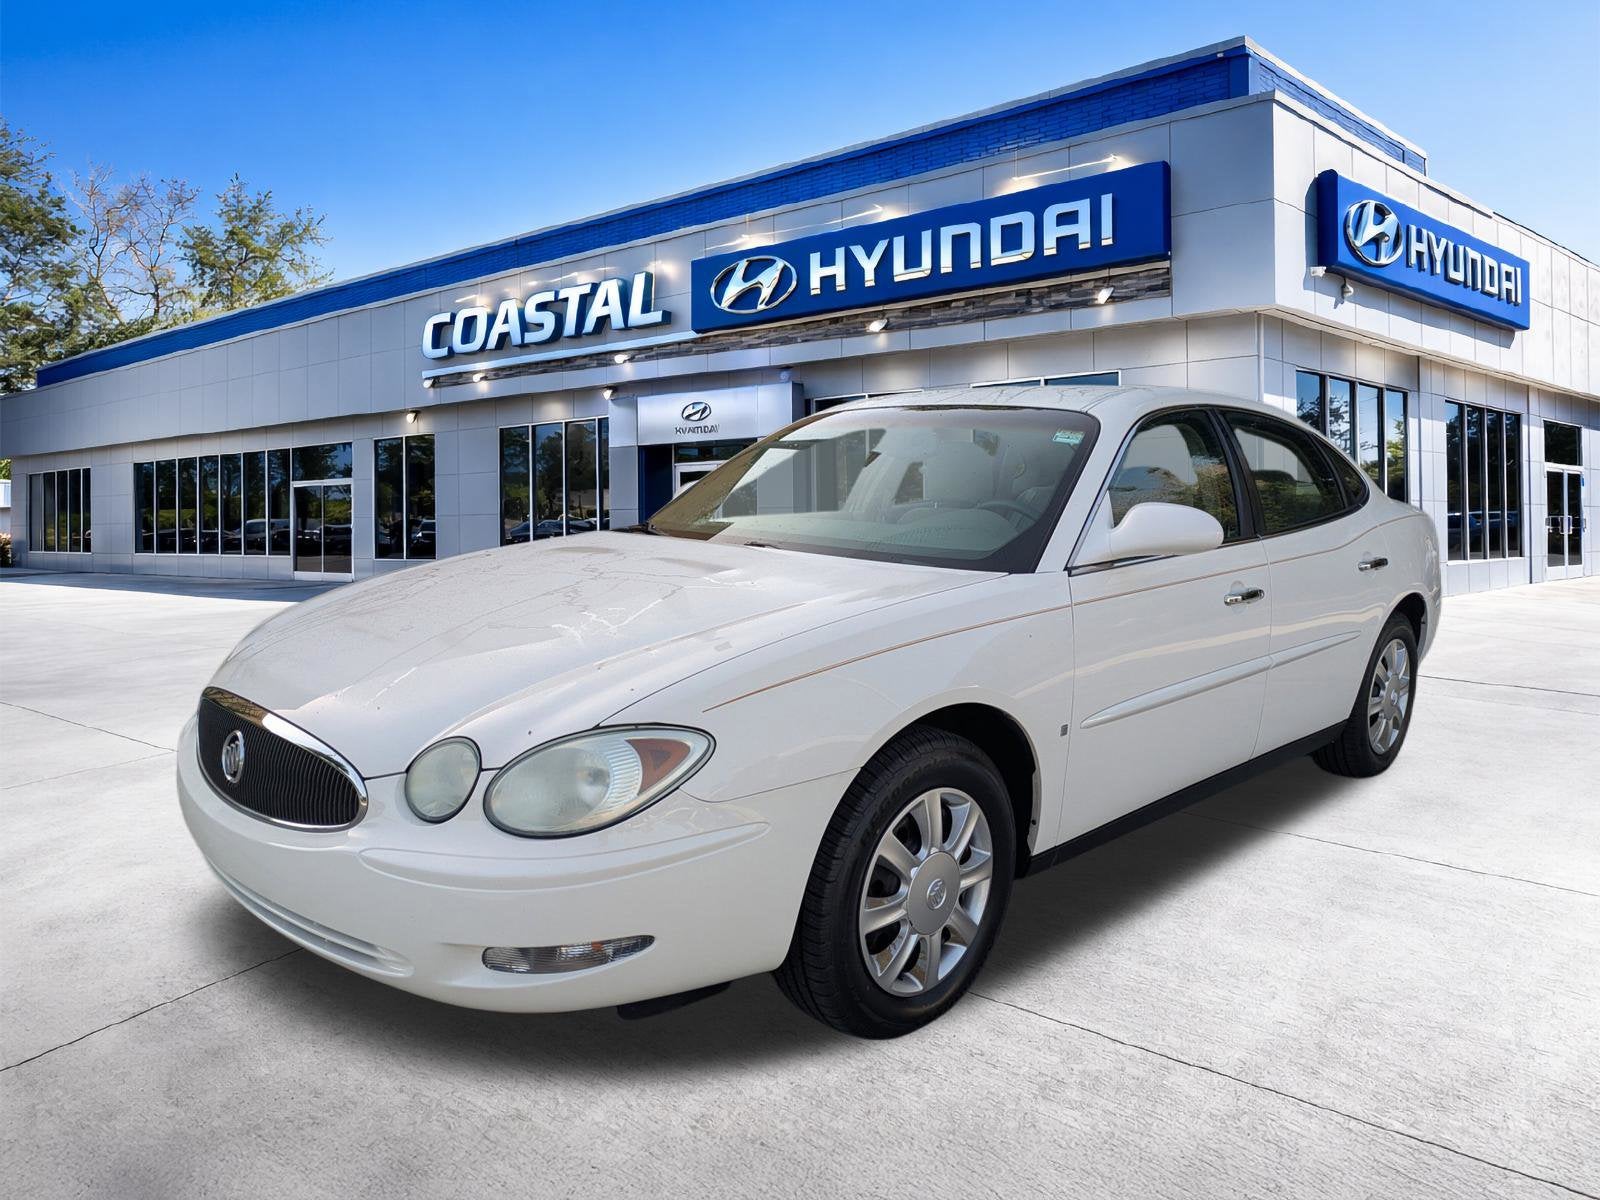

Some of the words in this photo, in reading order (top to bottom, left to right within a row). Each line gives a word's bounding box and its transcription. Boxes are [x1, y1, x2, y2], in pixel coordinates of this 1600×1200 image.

[810, 193, 1113, 295] HYUNDAI
[1407, 225, 1522, 306] HYUNDAI
[421, 271, 671, 360] COASTAL
